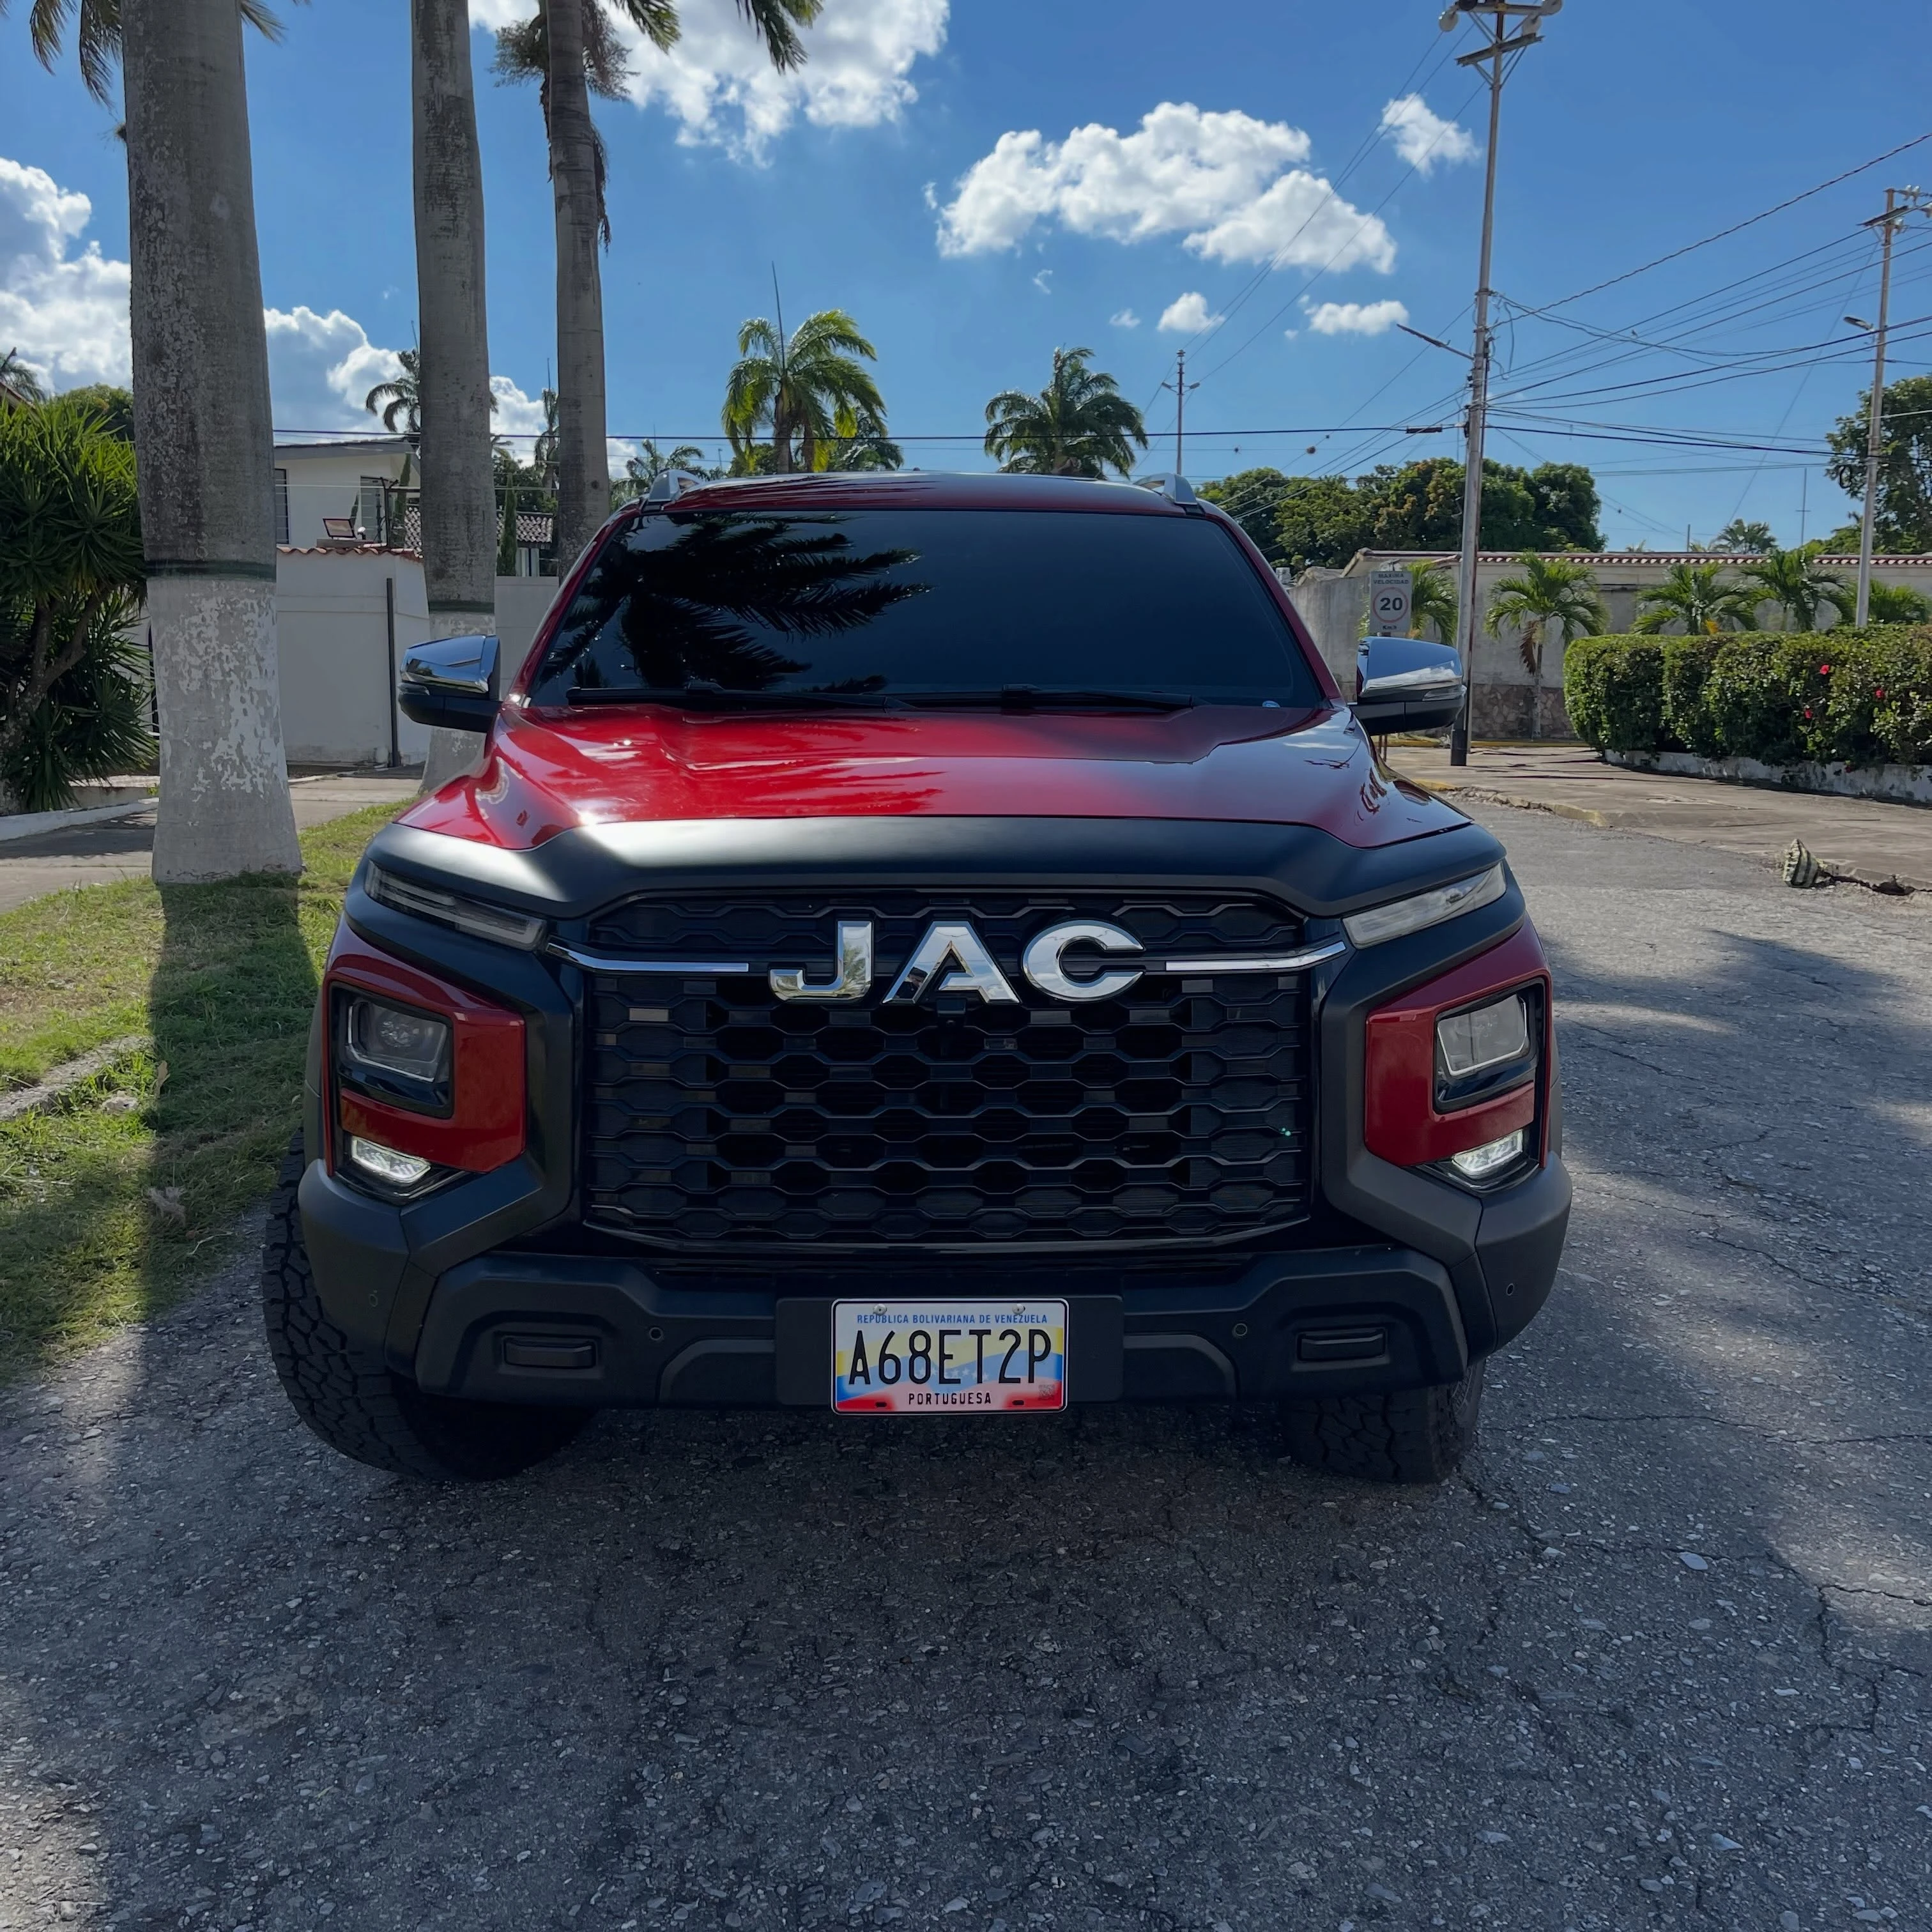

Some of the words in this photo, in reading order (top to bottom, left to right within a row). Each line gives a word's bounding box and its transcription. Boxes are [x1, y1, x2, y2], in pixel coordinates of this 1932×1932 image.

[1380, 597, 1403, 611] 20
[769, 919, 1146, 1004] JAC
[912, 1314, 976, 1324] BOLIVARIANA
[979, 1314, 991, 1324] DE
[994, 1314, 1048, 1324] VENEZUELA
[848, 1328, 1052, 1385] A68ET2P
[908, 1392, 992, 1405] PORTUGUESA
